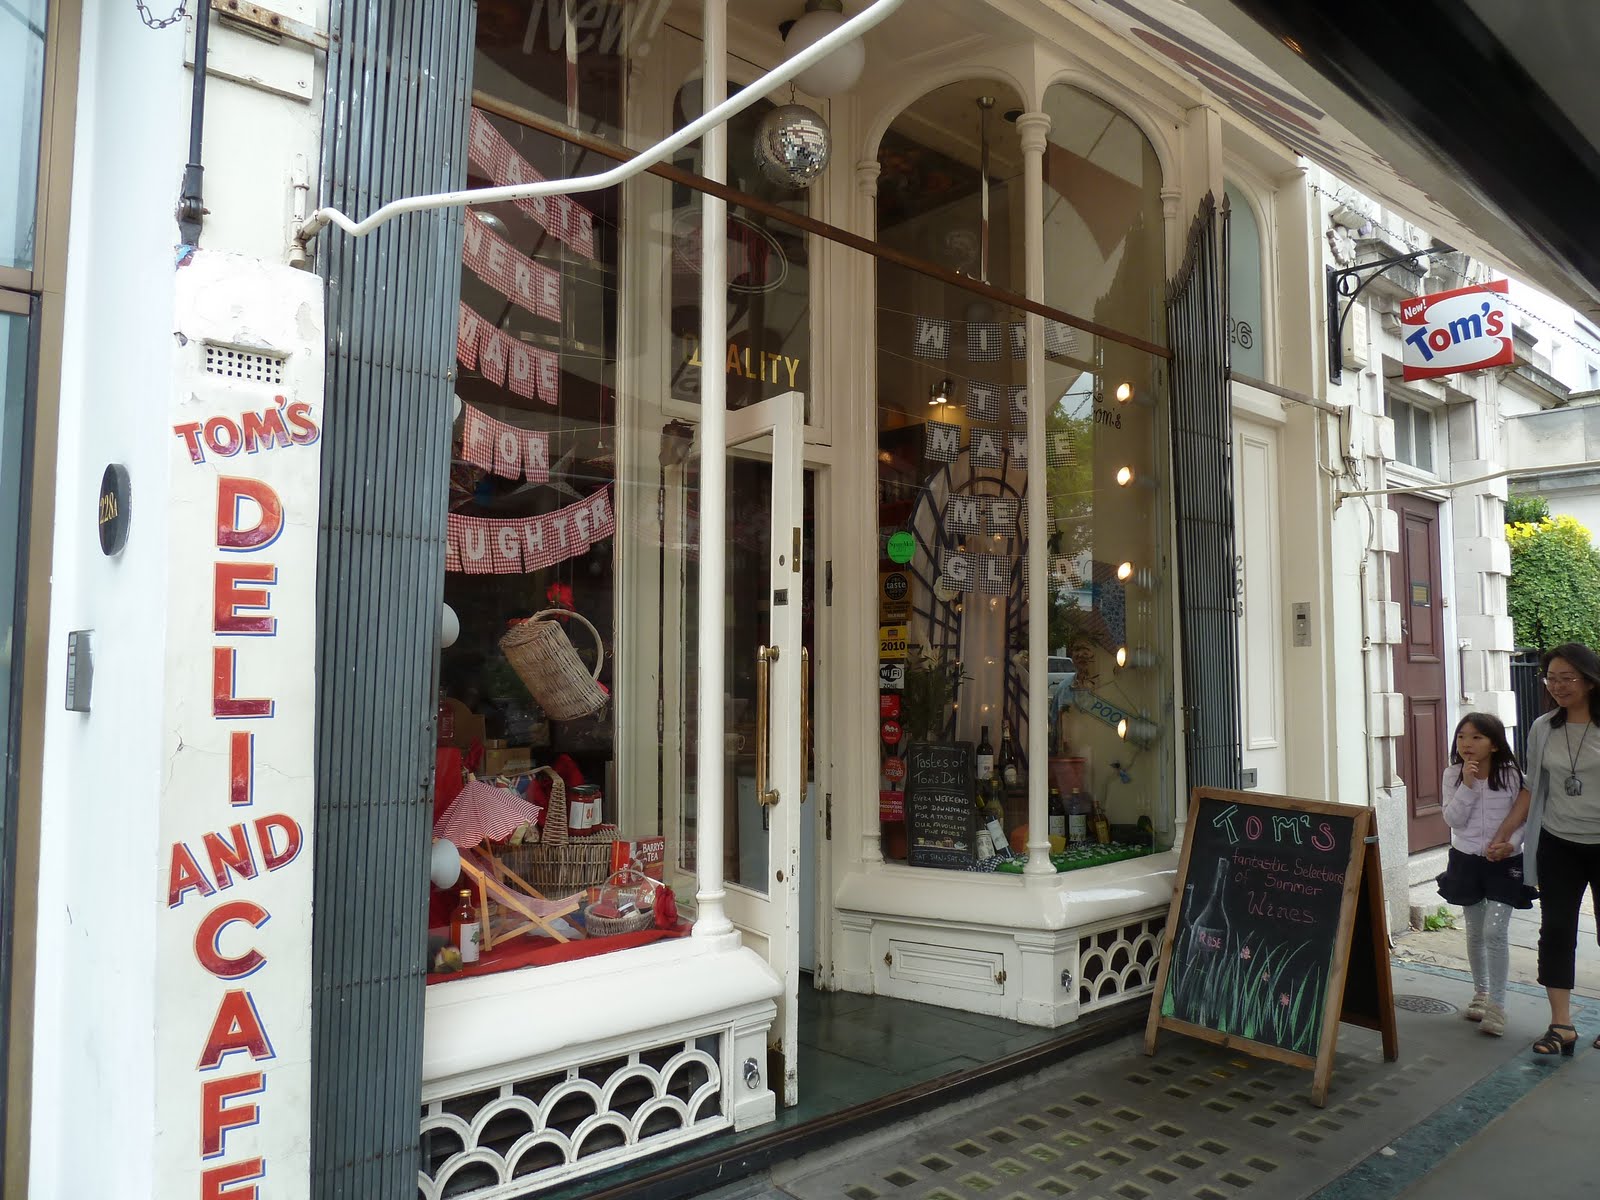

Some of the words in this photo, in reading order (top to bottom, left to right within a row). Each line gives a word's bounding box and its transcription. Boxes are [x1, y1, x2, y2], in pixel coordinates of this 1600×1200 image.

[1404, 299, 1428, 320] New!
[1405, 302, 1504, 362] Tom's
[173, 395, 320, 465] TOM'S
[469, 417, 546, 468] FOR
[946, 556, 1074, 583] GLD
[212, 475, 284, 806] DELI
[881, 641, 906, 651] 2010
[913, 752, 949, 768] Tastes
[913, 771, 939, 784] Tom's
[941, 771, 965, 785] Deli
[934, 795, 969, 805] WEEKEND
[166, 813, 302, 908] AND
[647, 853, 659, 862] TEA
